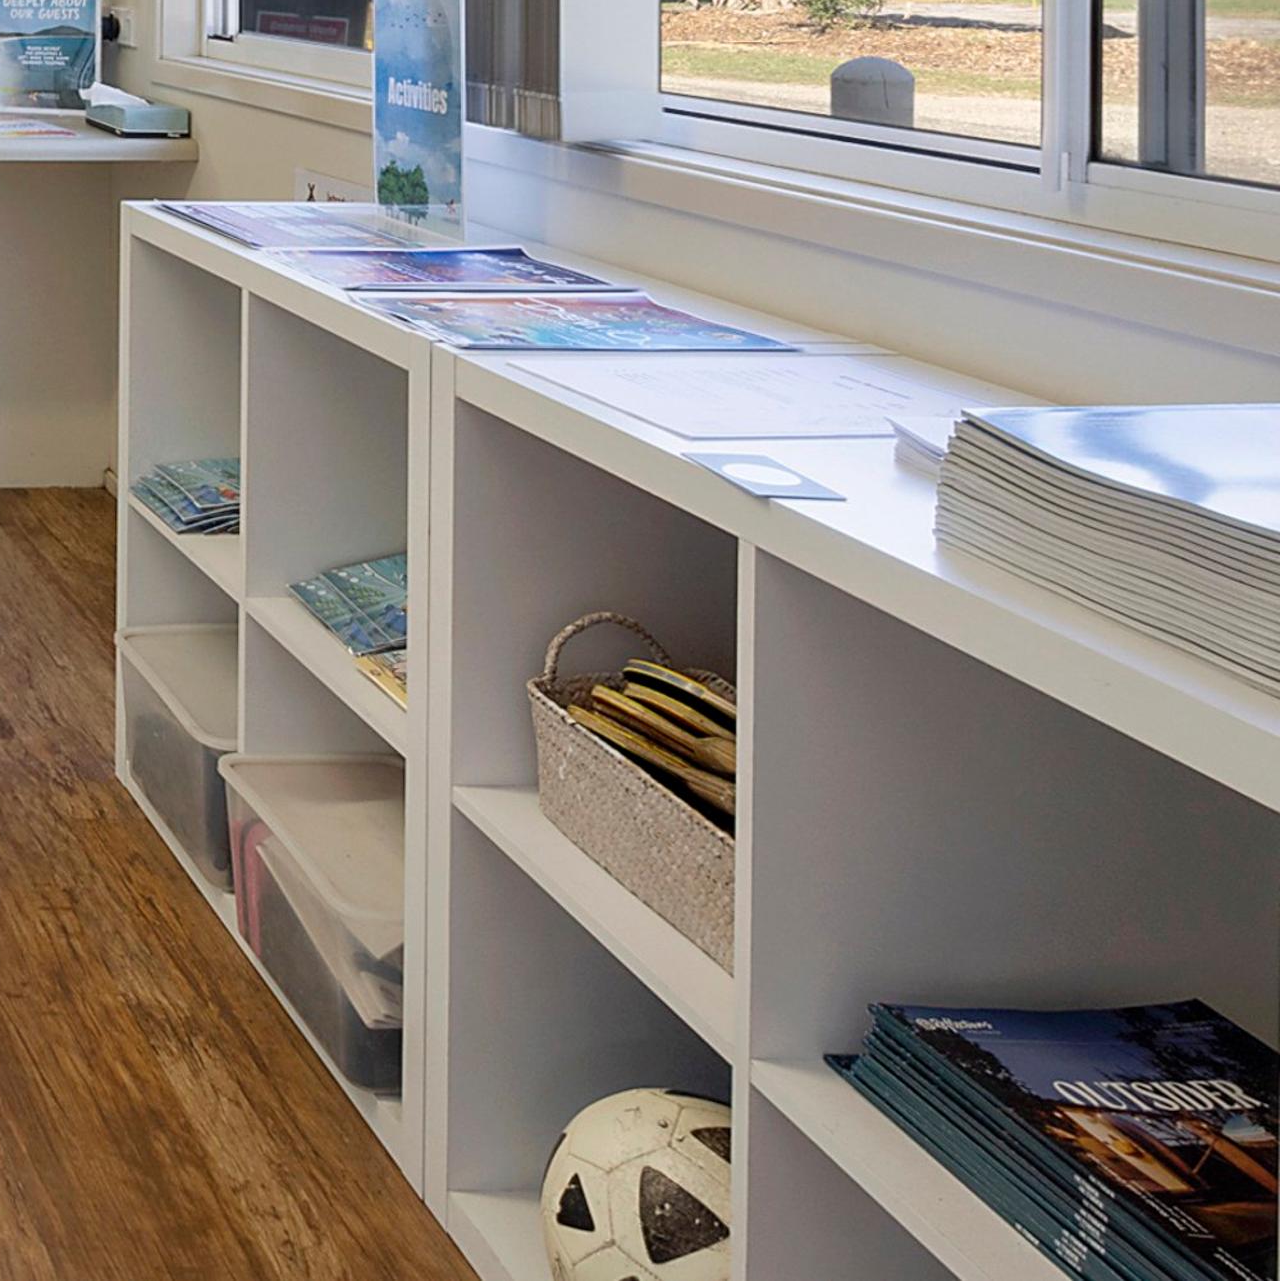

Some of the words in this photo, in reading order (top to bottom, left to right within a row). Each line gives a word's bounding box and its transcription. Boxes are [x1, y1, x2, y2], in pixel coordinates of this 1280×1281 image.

[10, 8, 35, 19] OUR
[38, 8, 80, 20] GUESTS
[388, 76, 448, 115] Activities
